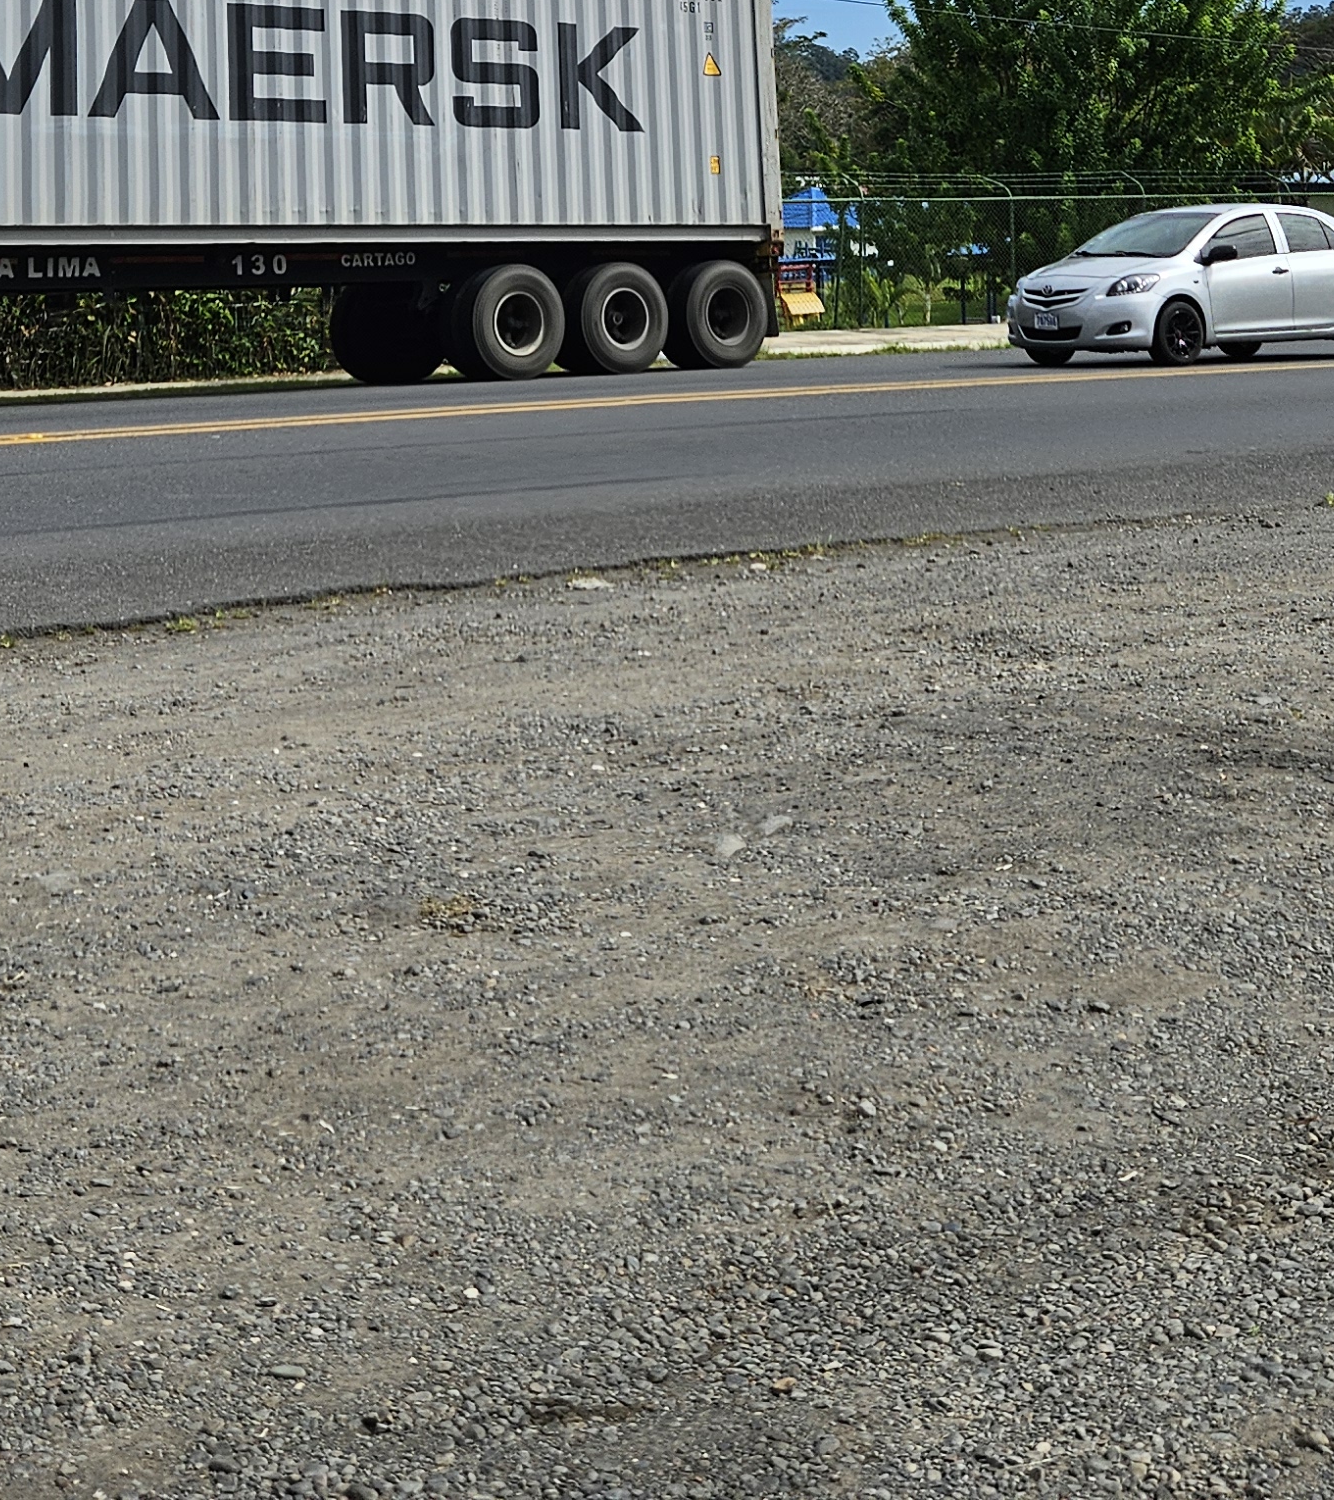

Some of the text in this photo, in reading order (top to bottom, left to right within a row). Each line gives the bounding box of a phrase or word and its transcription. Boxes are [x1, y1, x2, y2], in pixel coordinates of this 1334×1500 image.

[27, 256, 102, 278] LIMA
[231, 254, 288, 276] 130
[340, 251, 417, 268] CARTAGO
